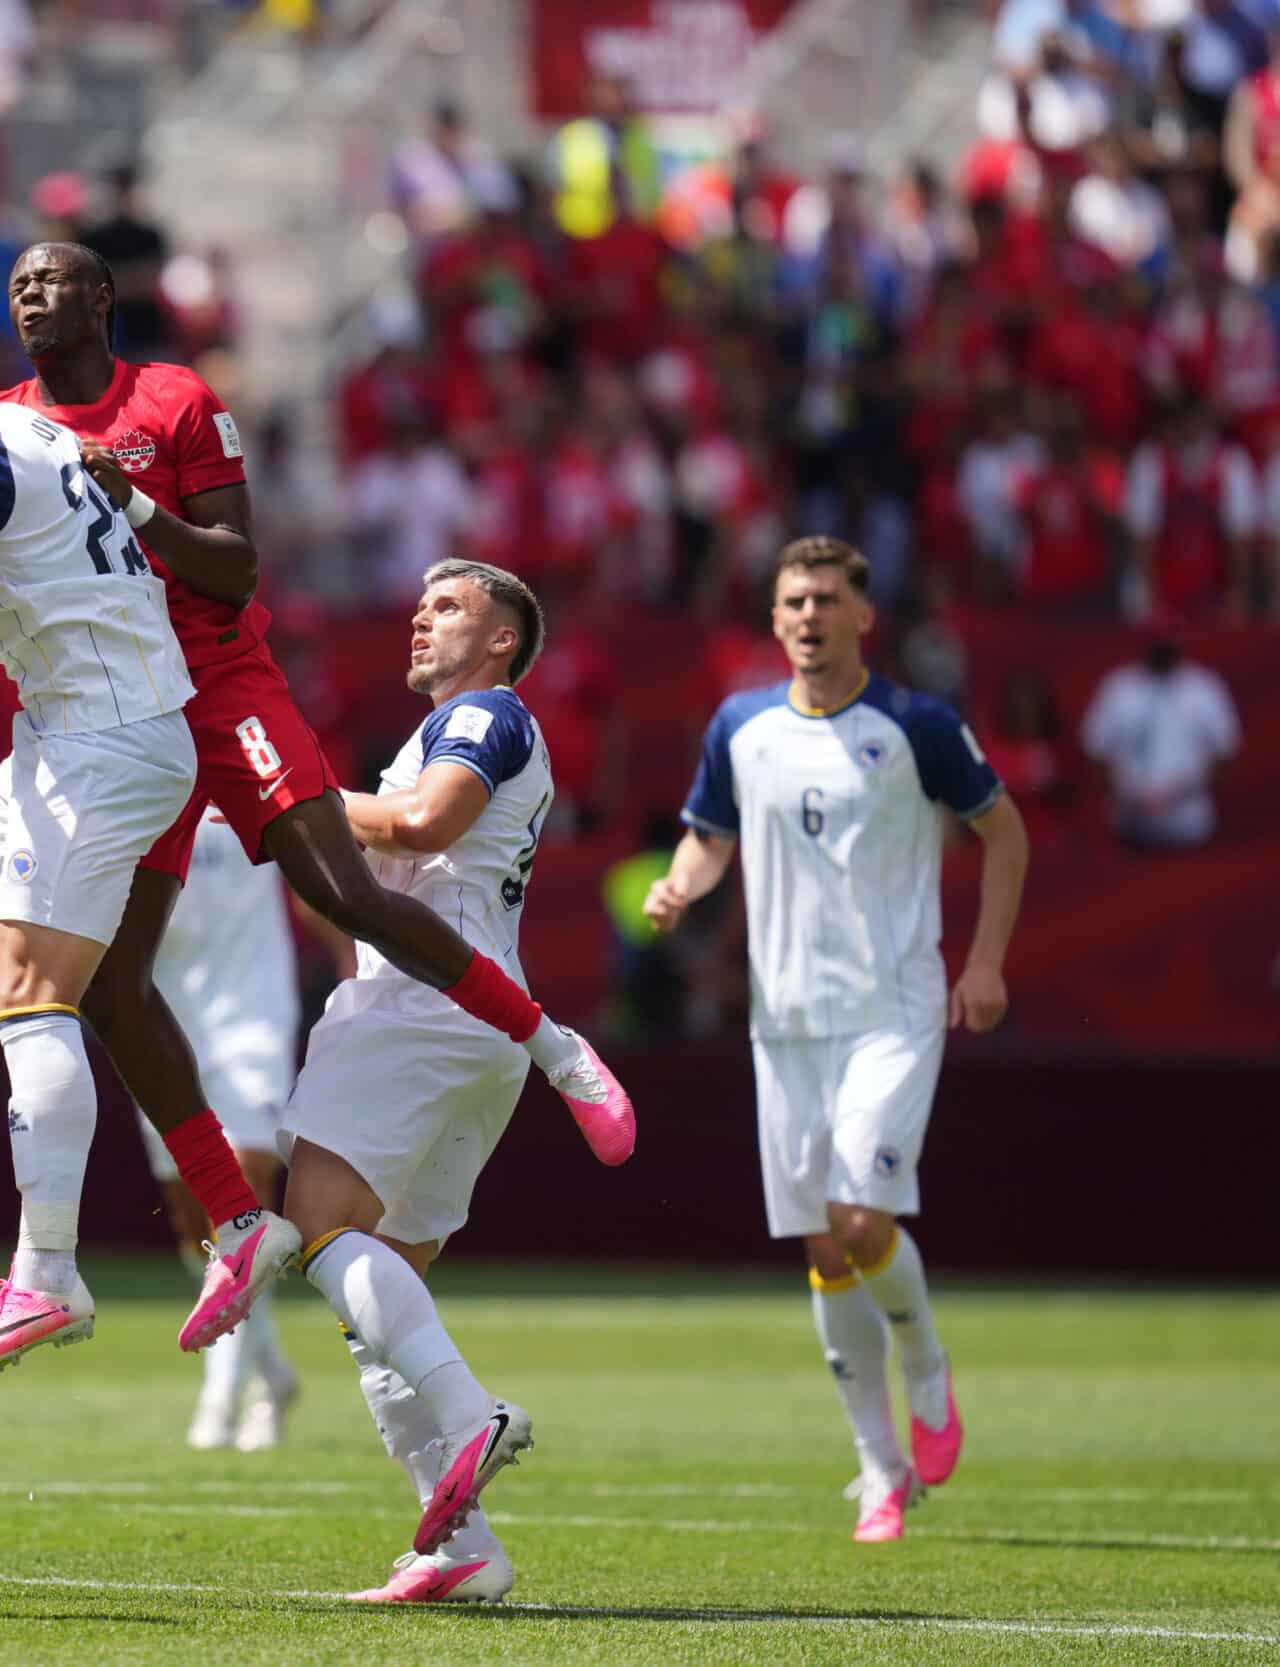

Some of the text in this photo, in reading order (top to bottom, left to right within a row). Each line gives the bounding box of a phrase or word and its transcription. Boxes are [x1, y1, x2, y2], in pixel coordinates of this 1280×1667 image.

[114, 445, 155, 459] CANADA
[235, 715, 282, 777] 8
[802, 787, 824, 836] 6
